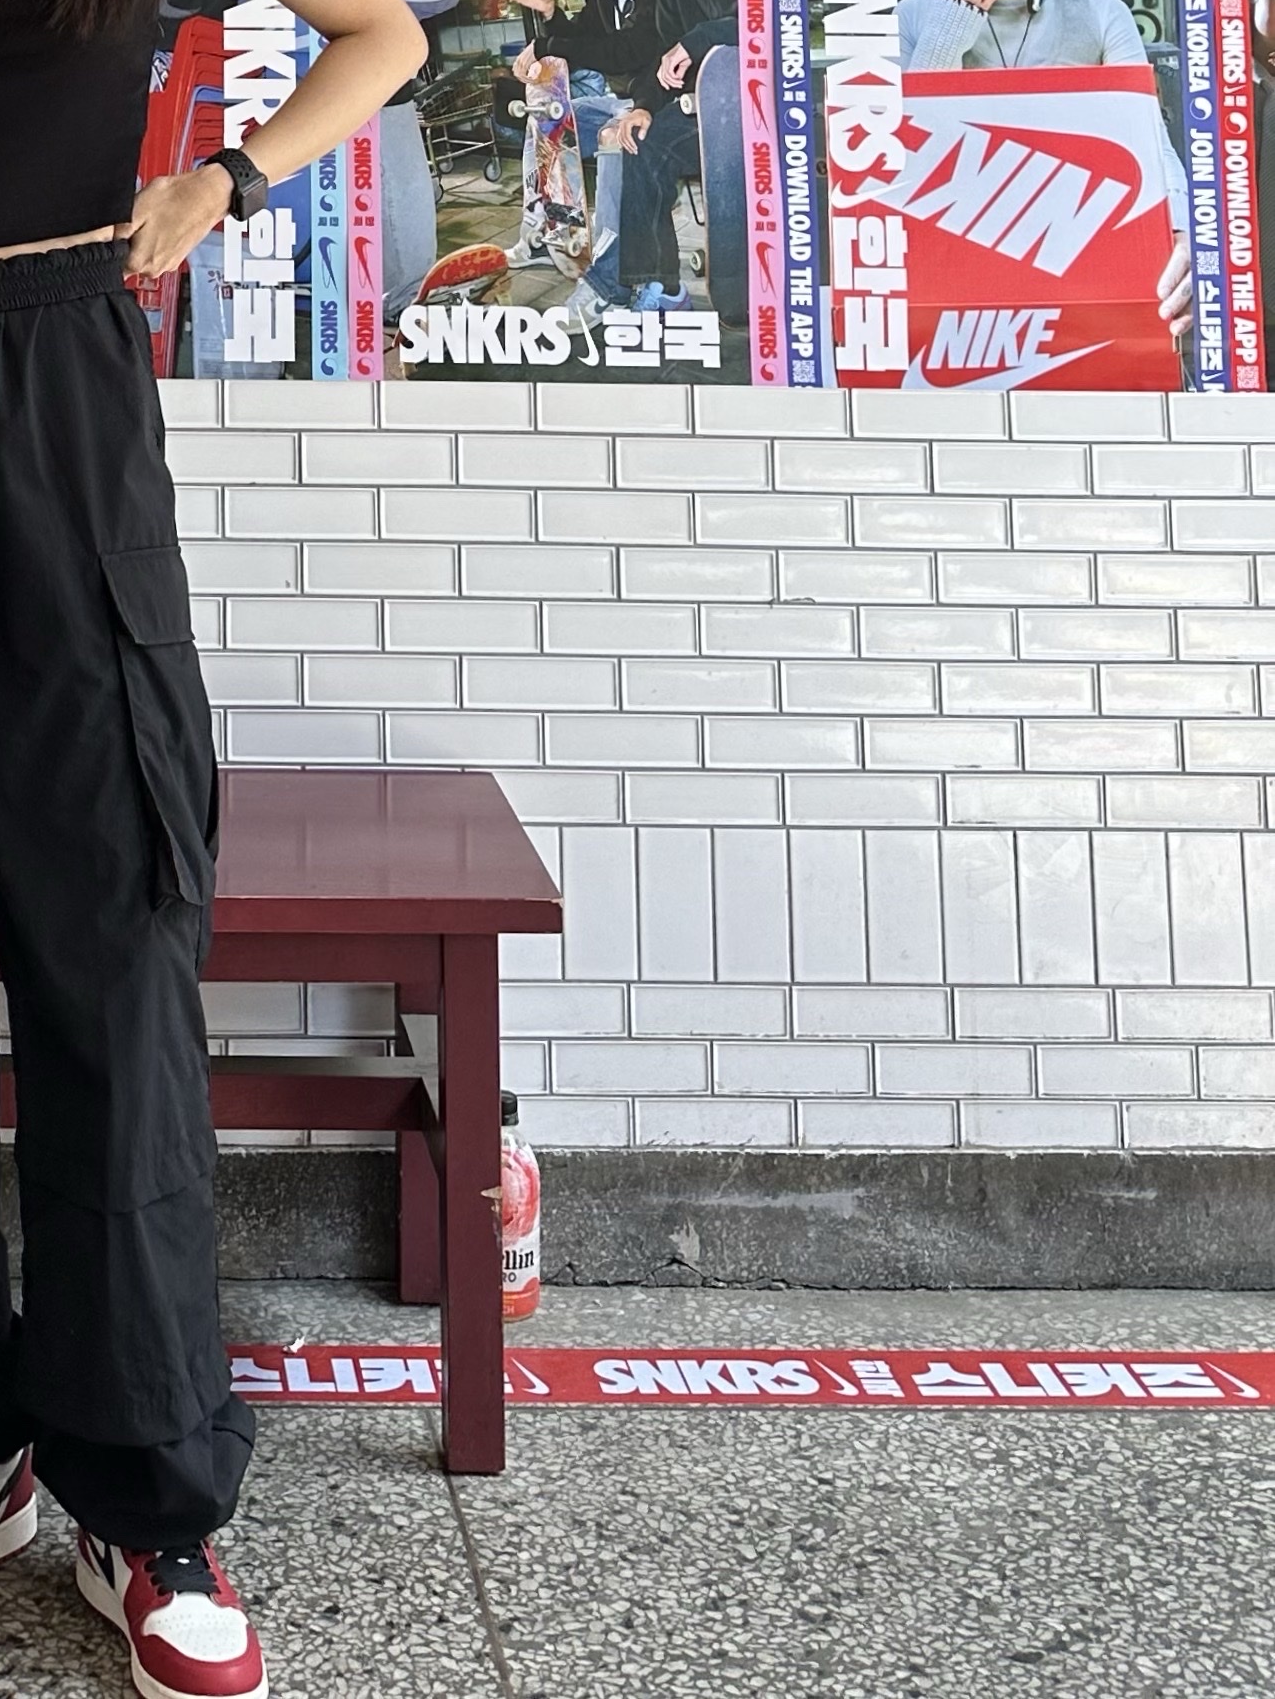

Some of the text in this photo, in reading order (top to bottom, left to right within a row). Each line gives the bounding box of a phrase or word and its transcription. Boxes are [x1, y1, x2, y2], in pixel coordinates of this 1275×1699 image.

[781, 15, 804, 78] SNKRS
[753, 143, 772, 194] SNKRS
[785, 135, 811, 261] DOWNLOAD
[223, 207, 296, 363] 한국
[790, 267, 812, 305] THE
[831, 215, 908, 371] 한국
[320, 300, 338, 354] SNKRS
[356, 300, 374, 354] SNKRS
[399, 303, 722, 369] SNKRS 한국
[759, 306, 777, 358] SNKRS
[791, 312, 813, 357] APP
[925, 307, 1062, 370] NIKE
[229, 1357, 510, 1394] 스니커
[593, 1358, 821, 1397] SNKRS
[911, 1361, 1226, 1399] 스니커즈
